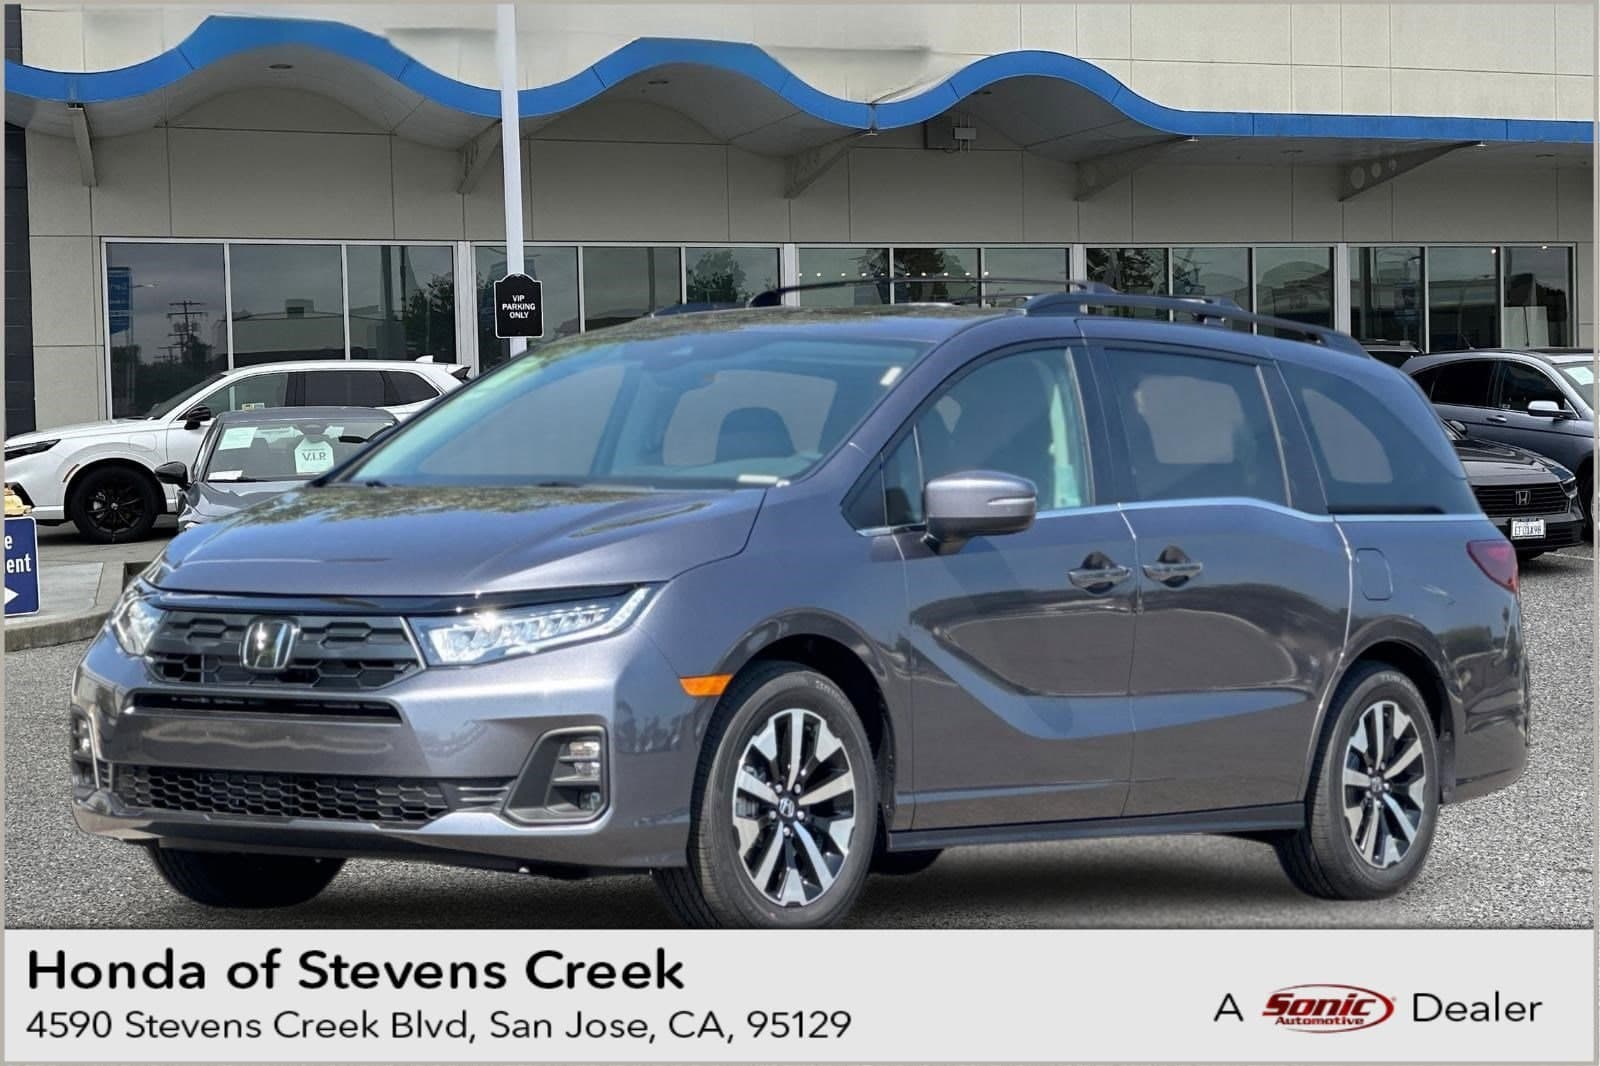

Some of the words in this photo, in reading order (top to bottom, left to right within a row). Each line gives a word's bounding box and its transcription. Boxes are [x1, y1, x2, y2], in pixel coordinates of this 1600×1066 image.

[512, 294, 525, 302] VIP
[502, 303, 535, 311] PARKING
[509, 311, 529, 319] ONLY
